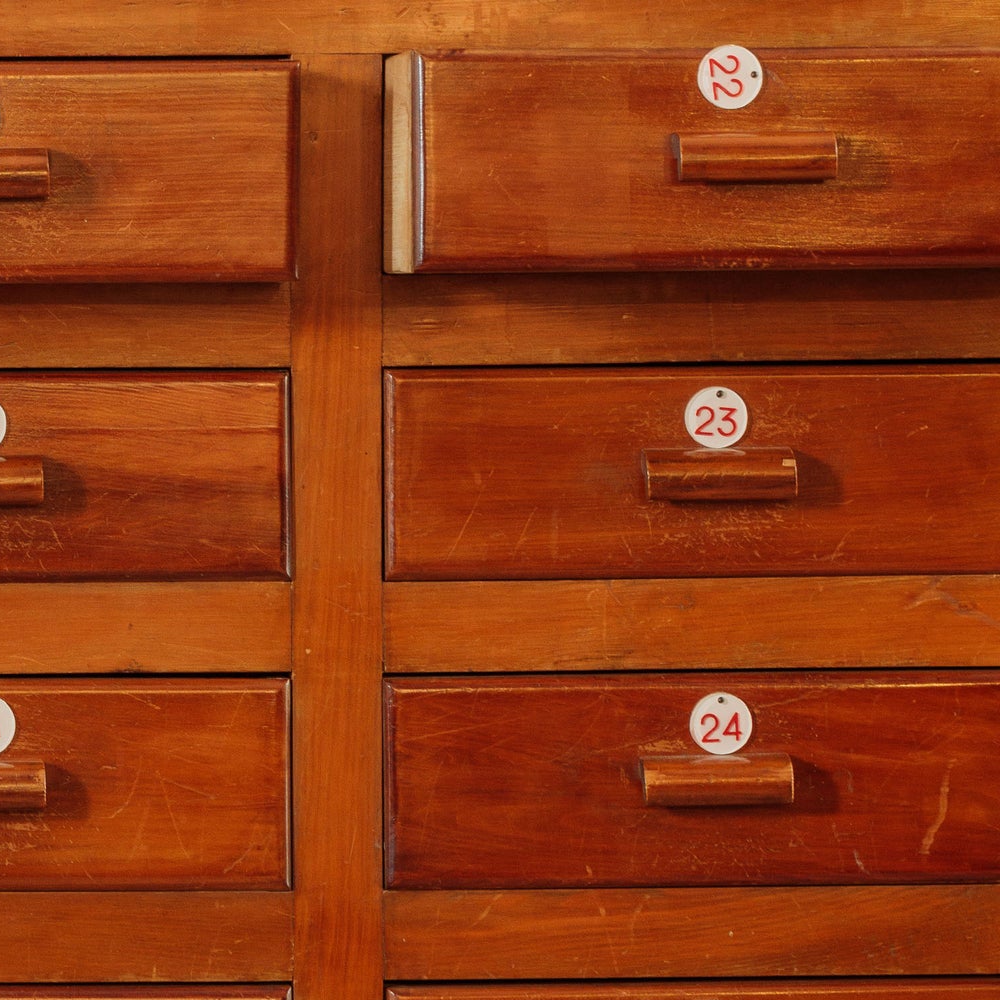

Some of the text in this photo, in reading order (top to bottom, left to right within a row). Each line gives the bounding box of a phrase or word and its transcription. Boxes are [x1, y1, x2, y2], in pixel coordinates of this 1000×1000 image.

[708, 55, 744, 100] 22
[694, 405, 738, 437] 23
[700, 712, 743, 744] 24
